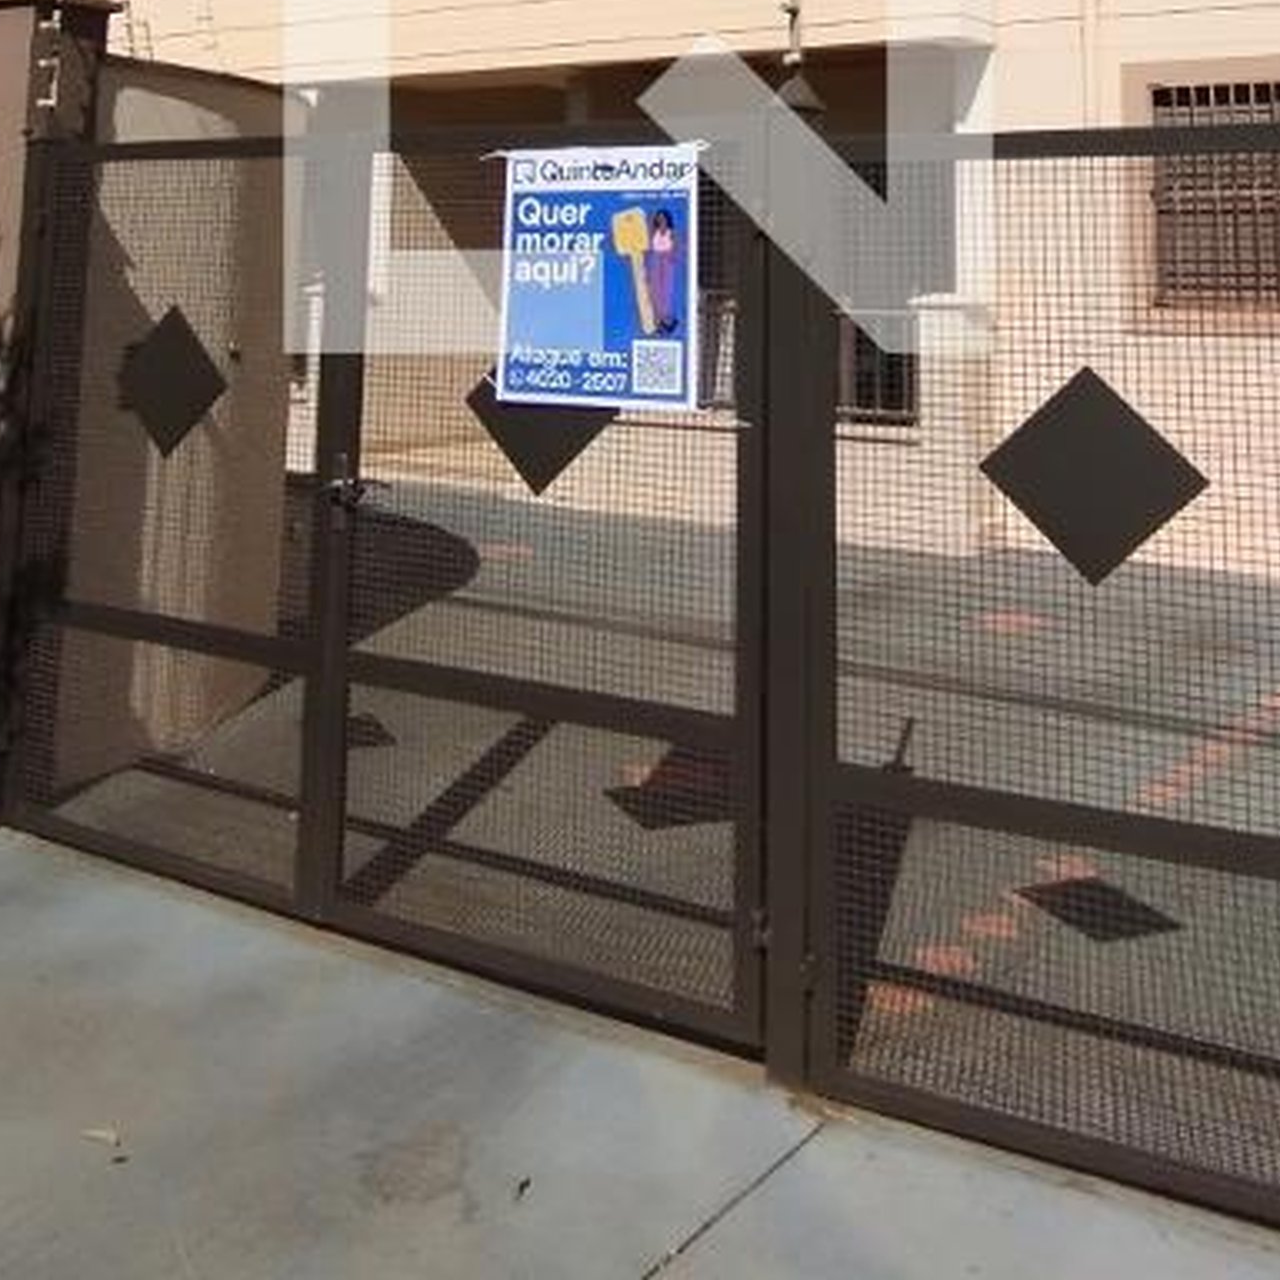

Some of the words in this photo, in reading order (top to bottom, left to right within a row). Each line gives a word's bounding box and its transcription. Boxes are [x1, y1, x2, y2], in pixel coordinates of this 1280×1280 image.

[539, 158, 690, 182] QuintoAndar
[518, 197, 593, 226] Quer
[516, 231, 605, 255] morar
[515, 255, 596, 289] aqui?
